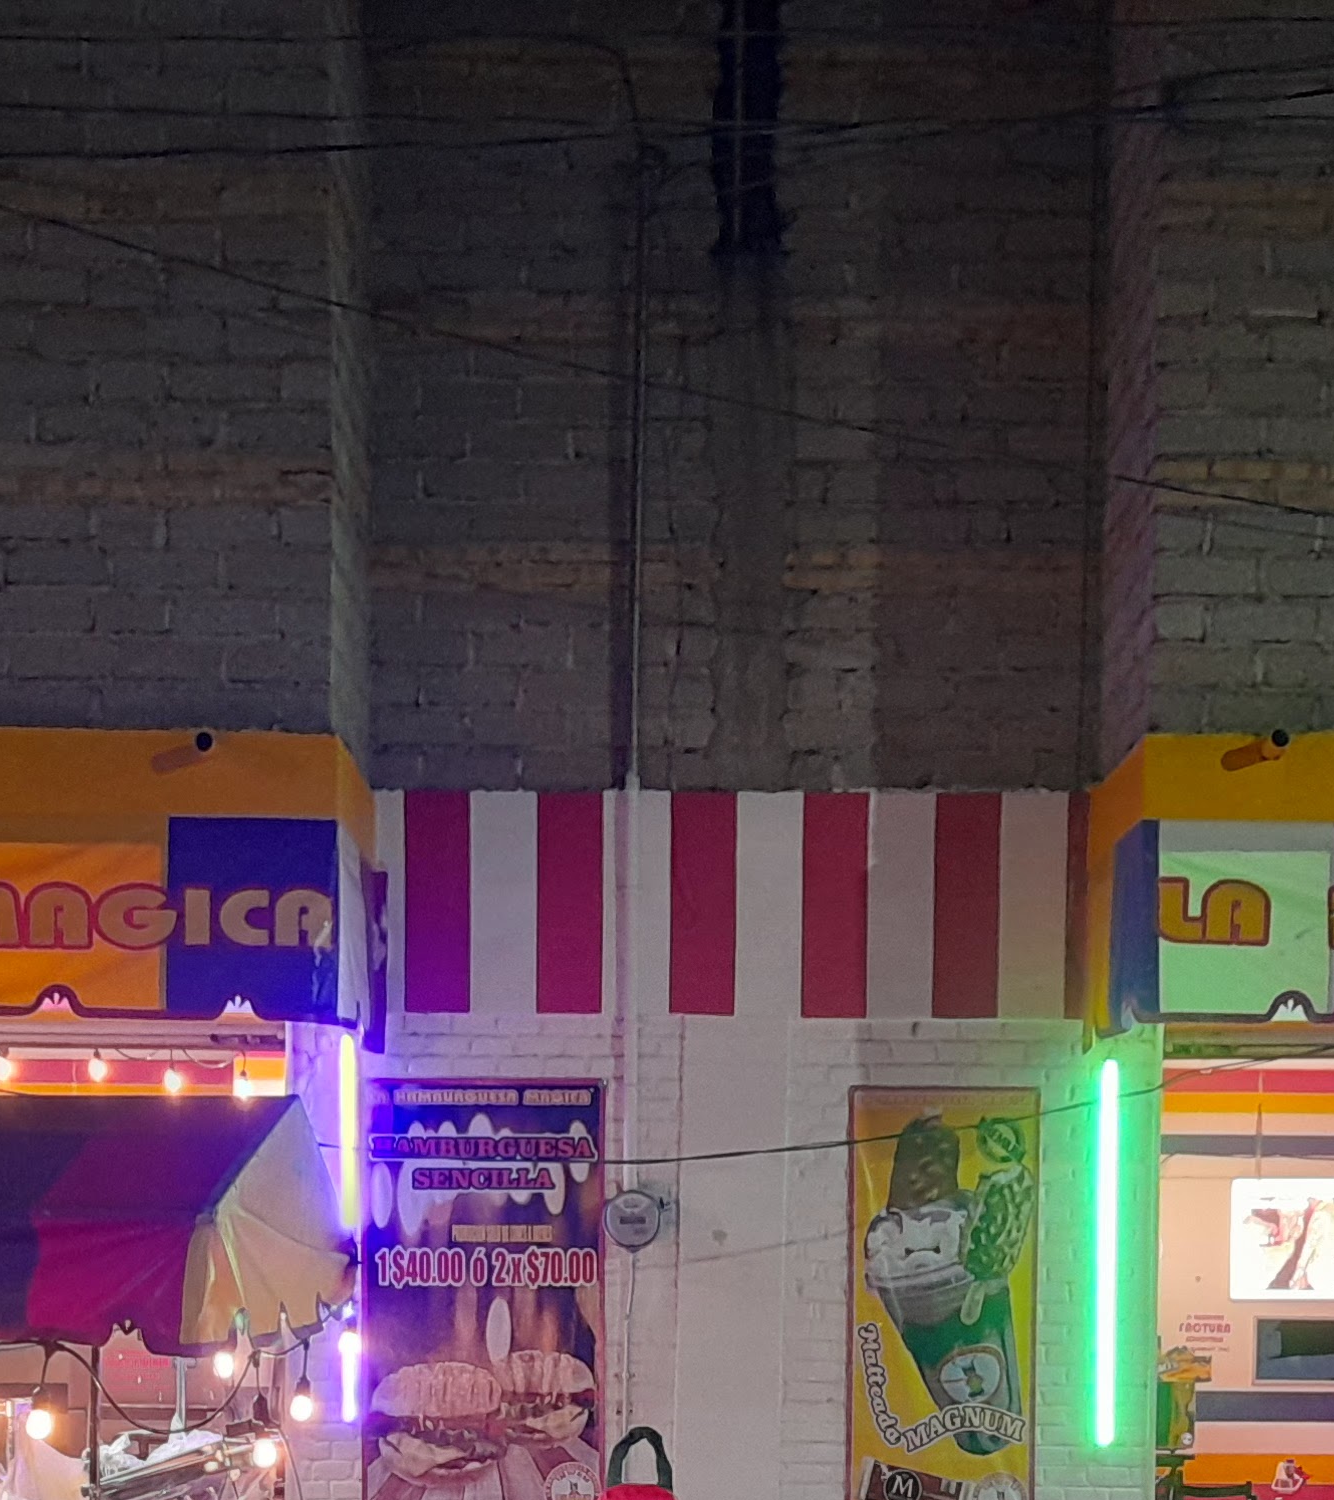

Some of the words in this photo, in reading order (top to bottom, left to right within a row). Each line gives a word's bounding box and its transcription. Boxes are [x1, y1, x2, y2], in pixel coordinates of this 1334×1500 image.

[1157, 877, 1272, 946] LA
[371, 1136, 596, 1160] HAMBURGUESA
[412, 1167, 556, 1191] SENCILLA
[901, 1406, 1026, 1453] MAGNUM
